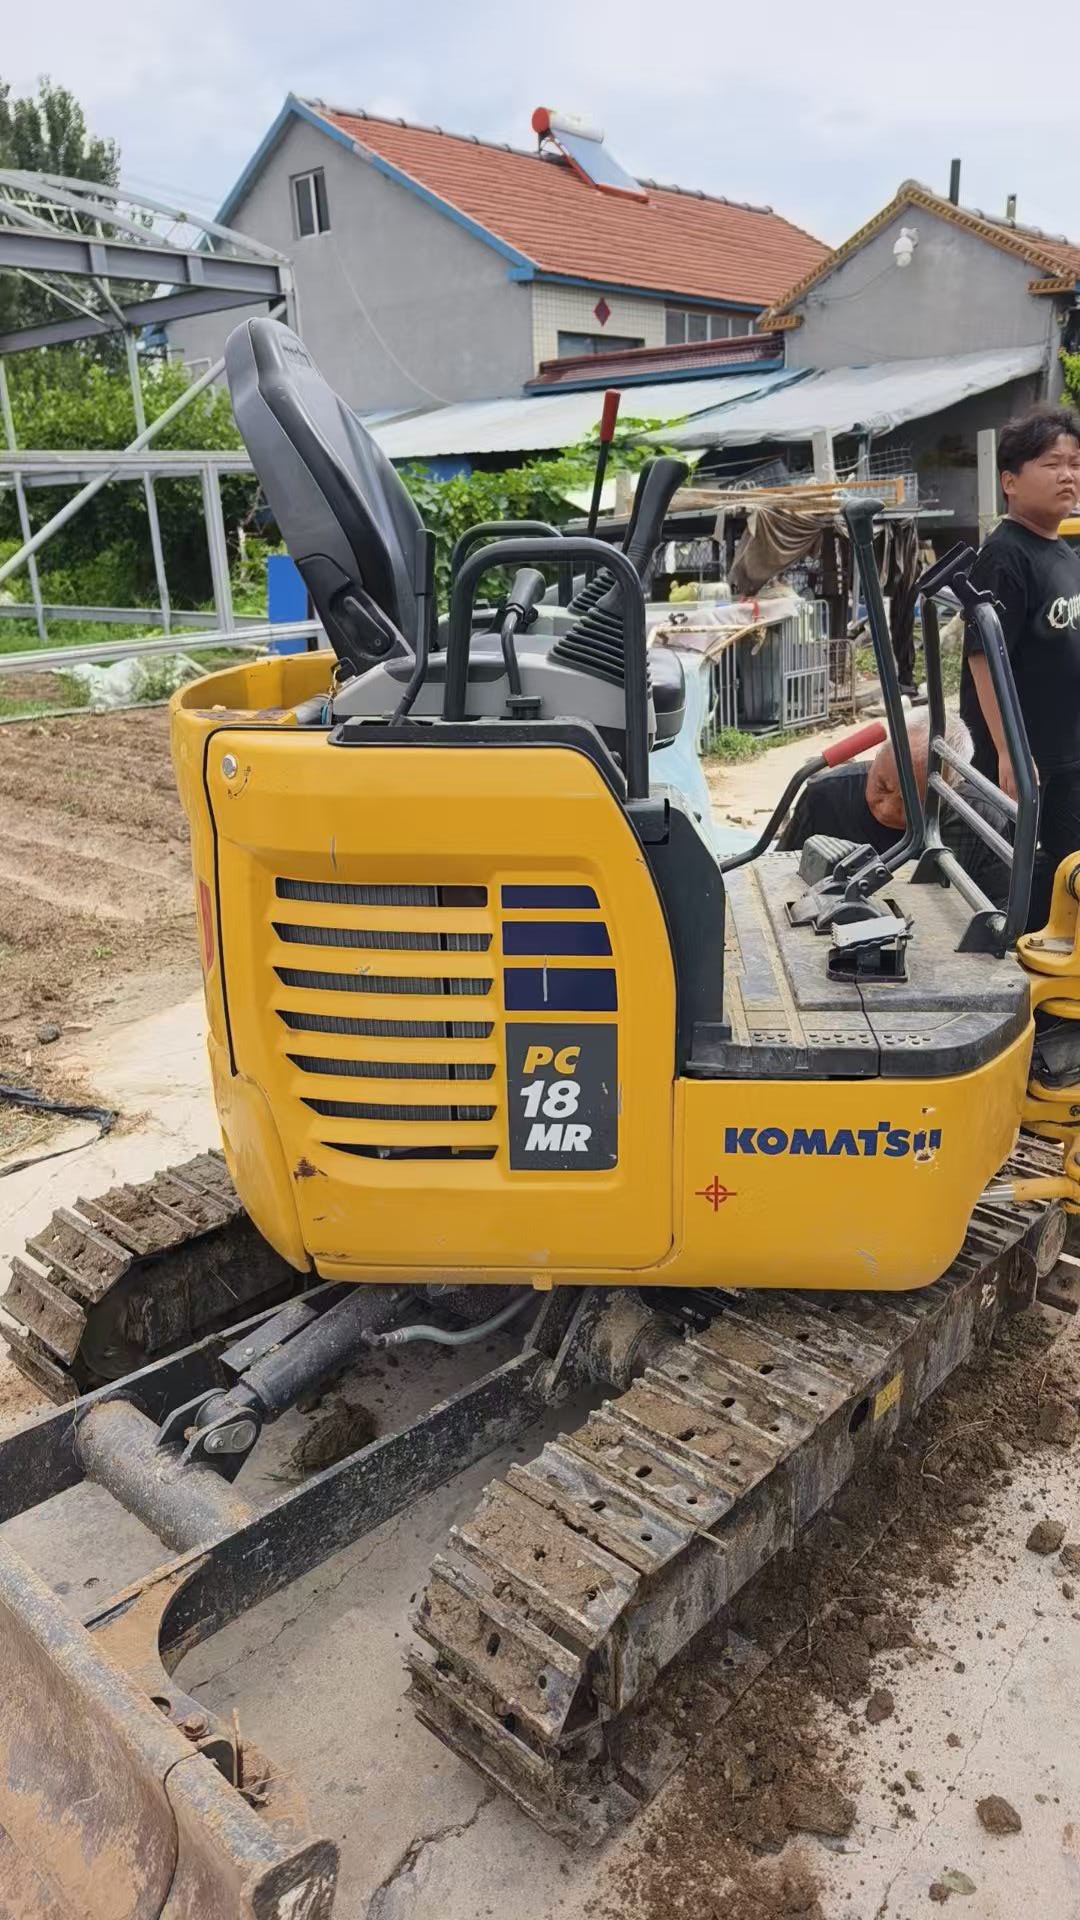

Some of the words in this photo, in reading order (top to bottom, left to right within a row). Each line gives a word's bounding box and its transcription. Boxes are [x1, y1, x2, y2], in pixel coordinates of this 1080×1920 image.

[522, 1045, 581, 1075] PC
[520, 1079, 581, 1119] 18
[524, 1123, 592, 1152] MR
